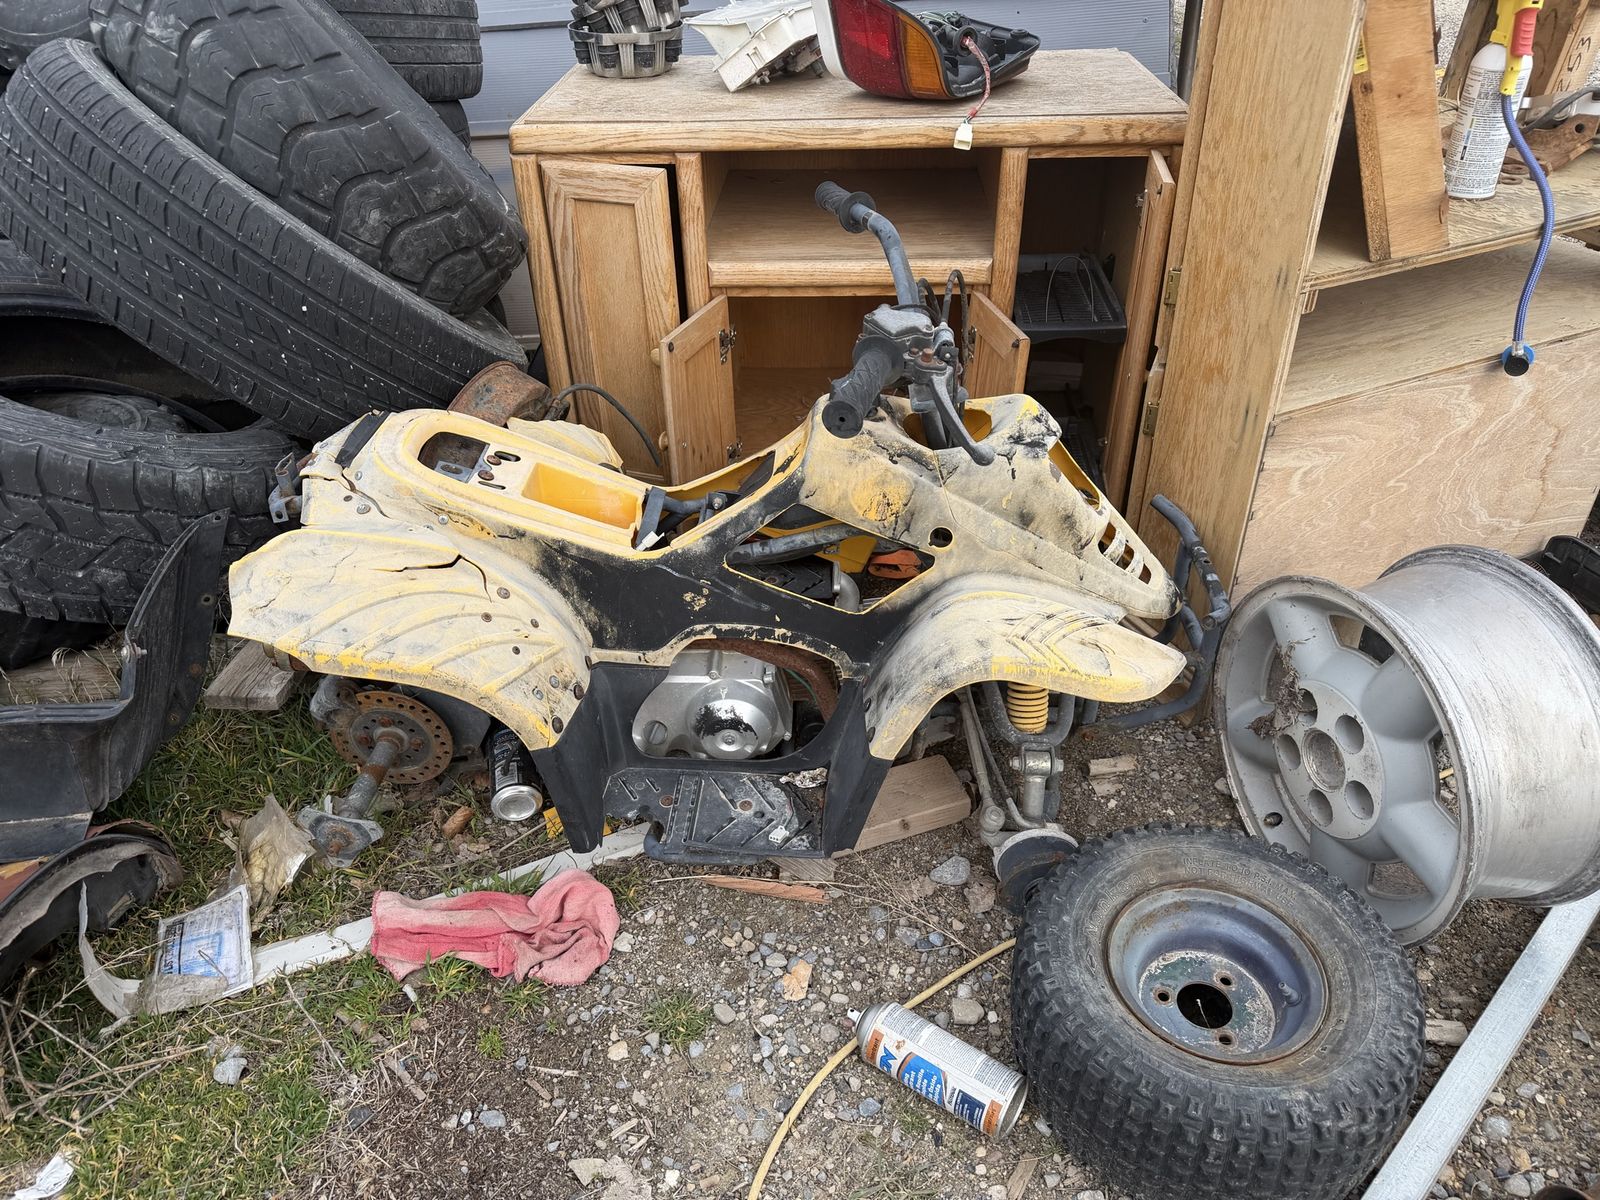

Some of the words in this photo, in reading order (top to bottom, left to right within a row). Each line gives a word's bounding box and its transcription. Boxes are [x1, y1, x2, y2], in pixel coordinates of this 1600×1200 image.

[1184, 857, 1221, 868] INFLATE
[1226, 864, 1238, 873] TO
[1184, 866, 1206, 877] NOT
[1207, 868, 1227, 880] FOR
